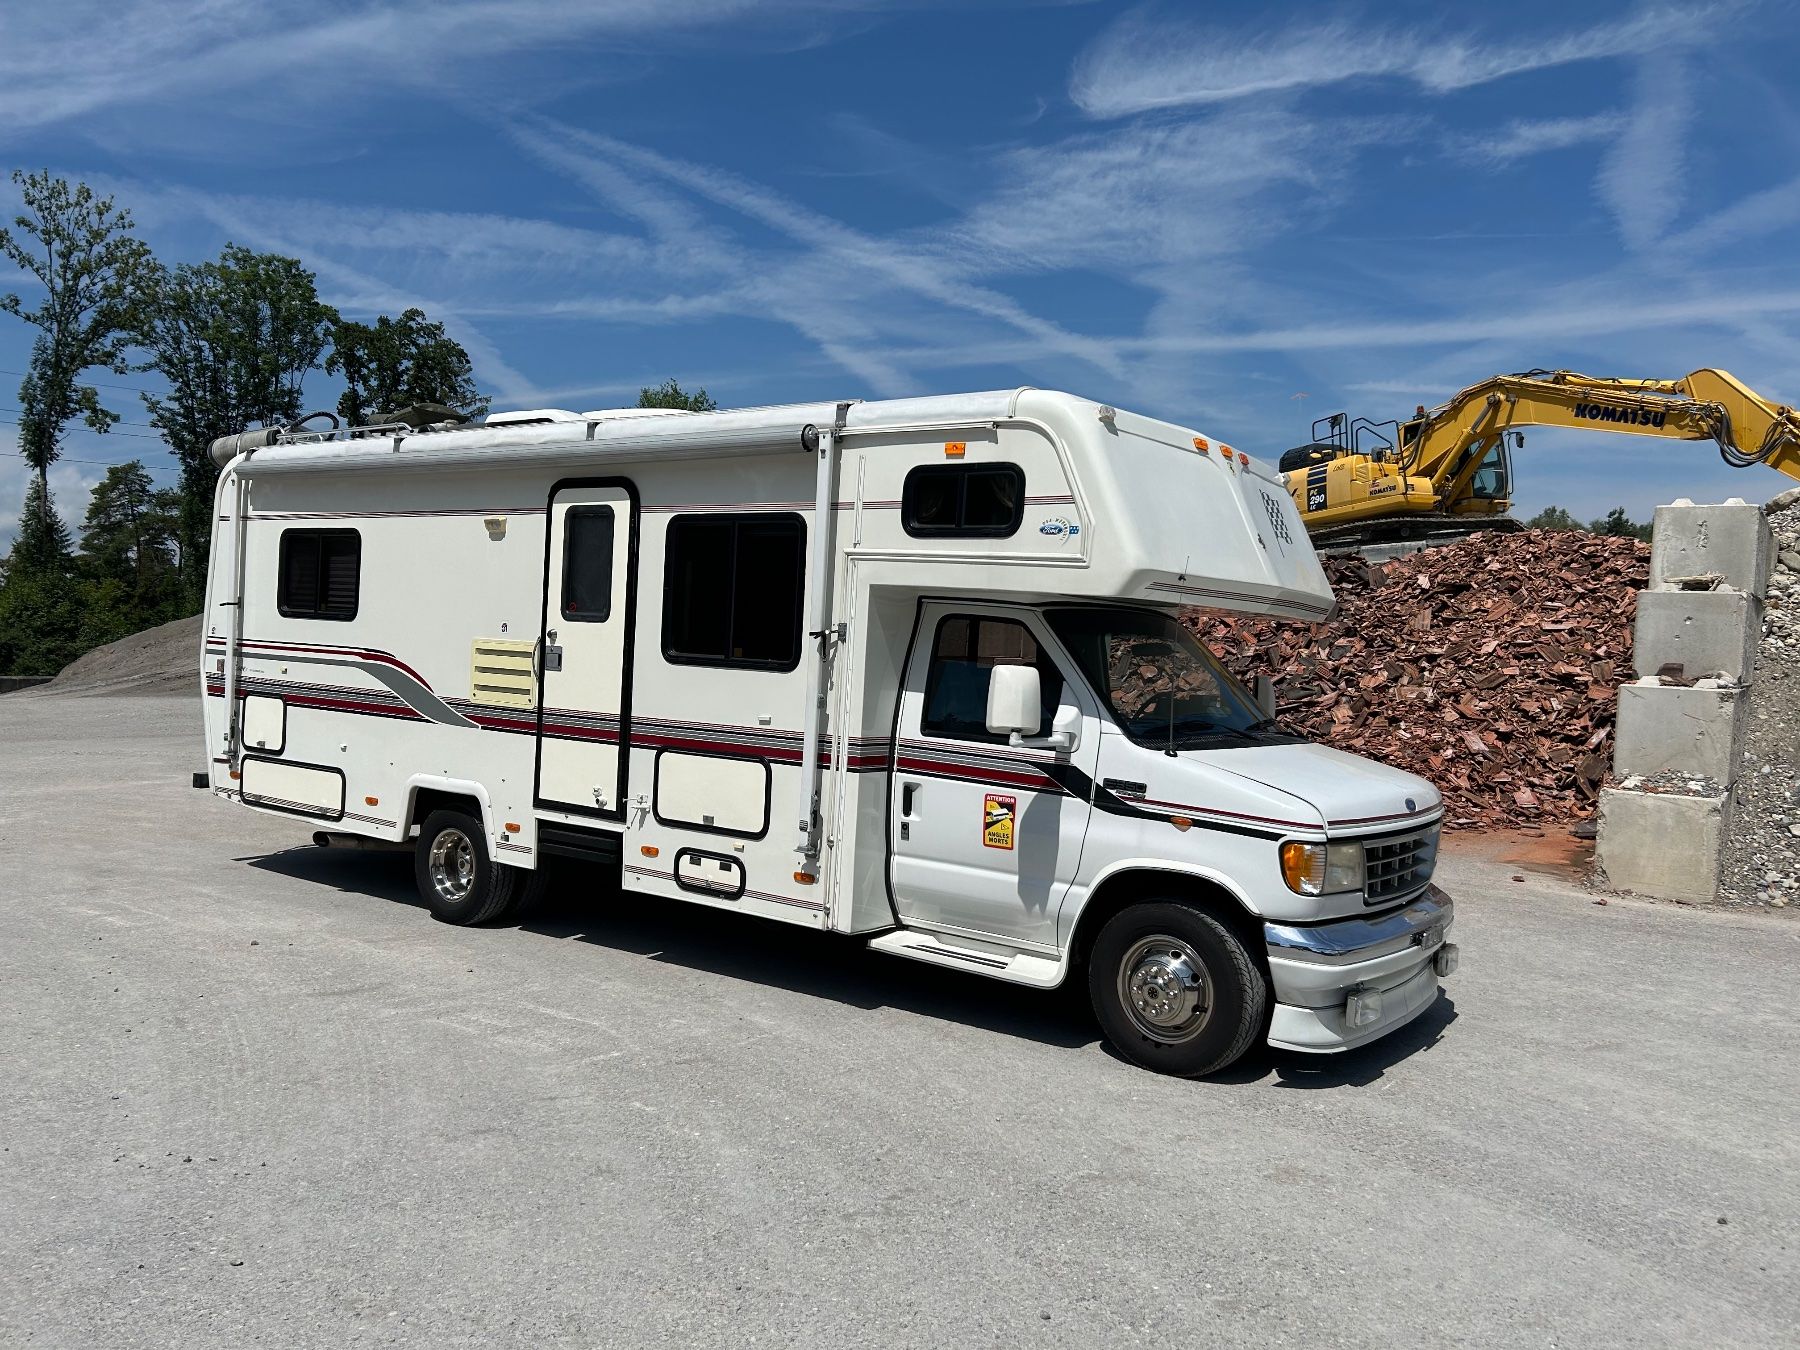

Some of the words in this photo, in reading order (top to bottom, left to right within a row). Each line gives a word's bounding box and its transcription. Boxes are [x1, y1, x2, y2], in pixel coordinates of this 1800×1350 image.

[1574, 403, 1666, 428] KOMATSU
[1369, 485, 1397, 496] KOMATSU
[1310, 494, 1325, 505] 290
[986, 795, 1015, 803] ATTENTION
[988, 831, 1010, 839] ANGLES
[988, 837, 1009, 845] MORTS
